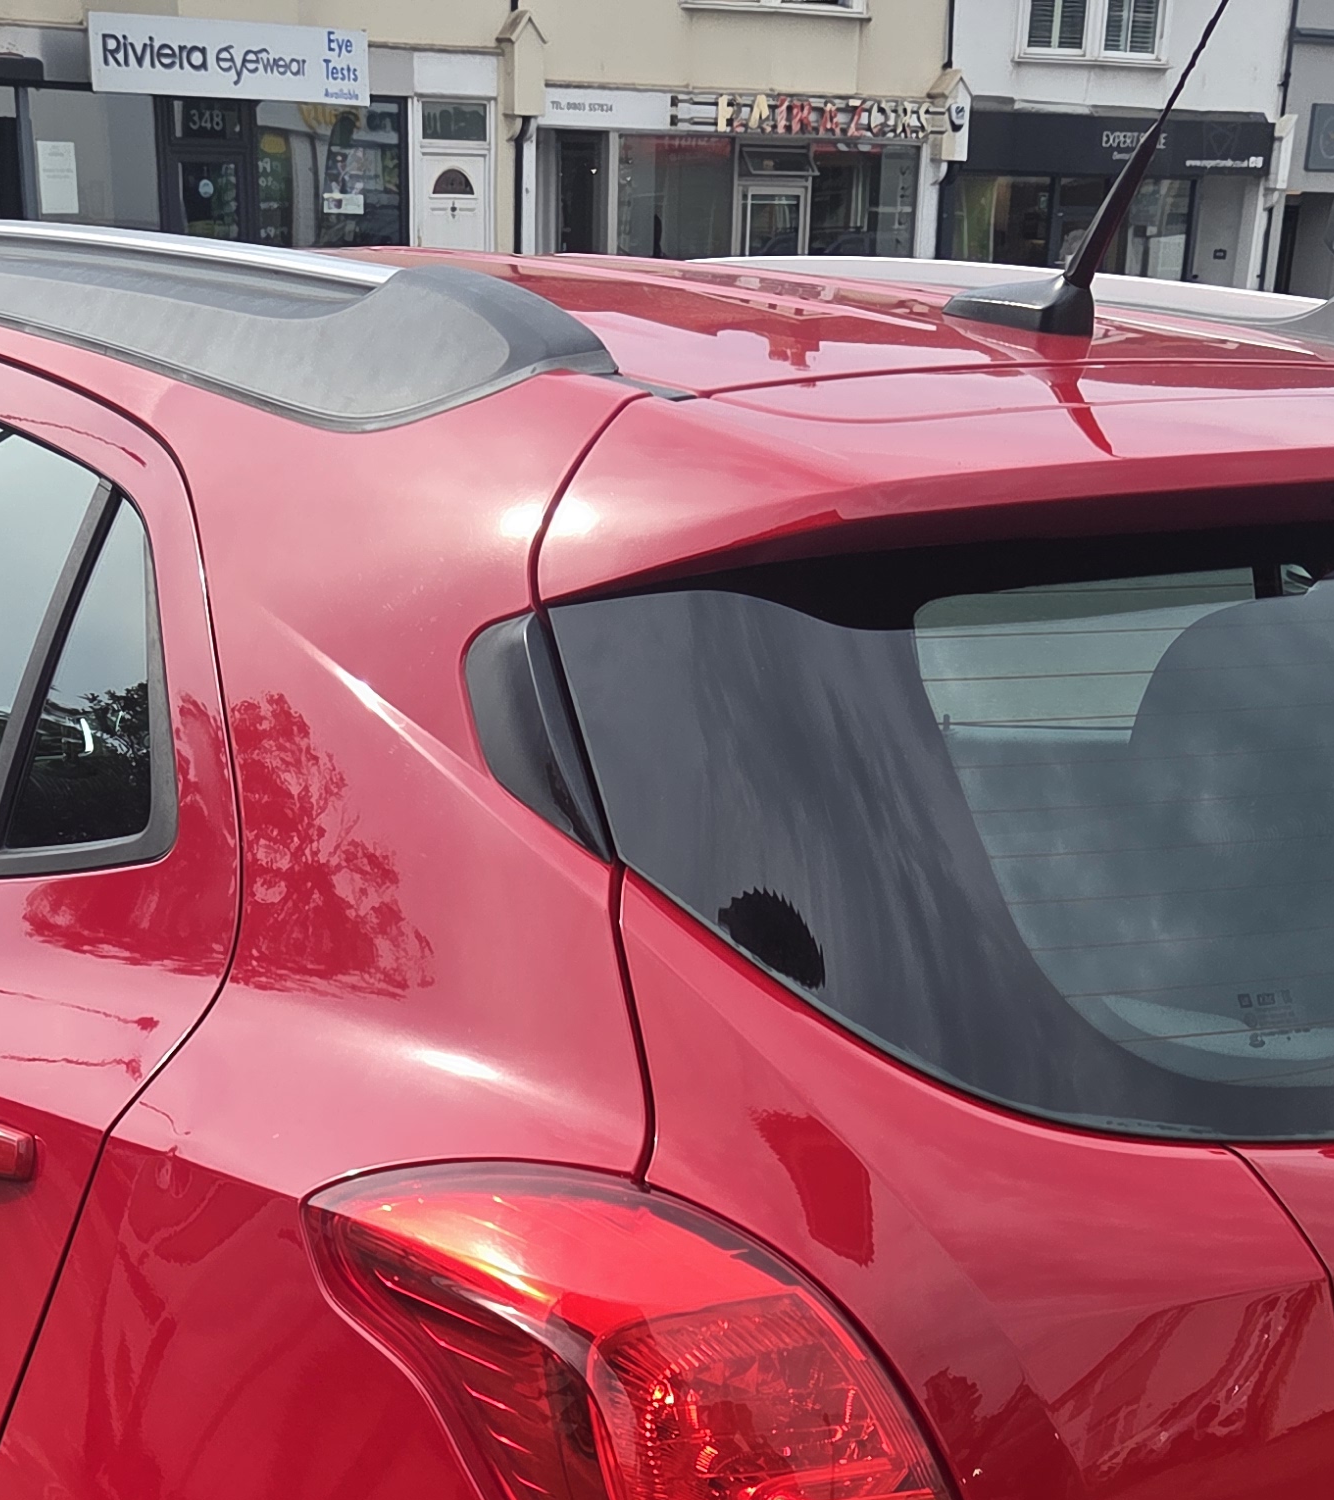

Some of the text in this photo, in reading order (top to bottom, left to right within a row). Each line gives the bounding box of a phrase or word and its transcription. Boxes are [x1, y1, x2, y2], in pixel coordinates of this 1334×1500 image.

[327, 31, 353, 57] Eye
[101, 33, 306, 86] Riviera eyewear
[323, 59, 359, 82] Tests
[189, 110, 223, 131] 348
[1102, 131, 1137, 148] EXPERT
